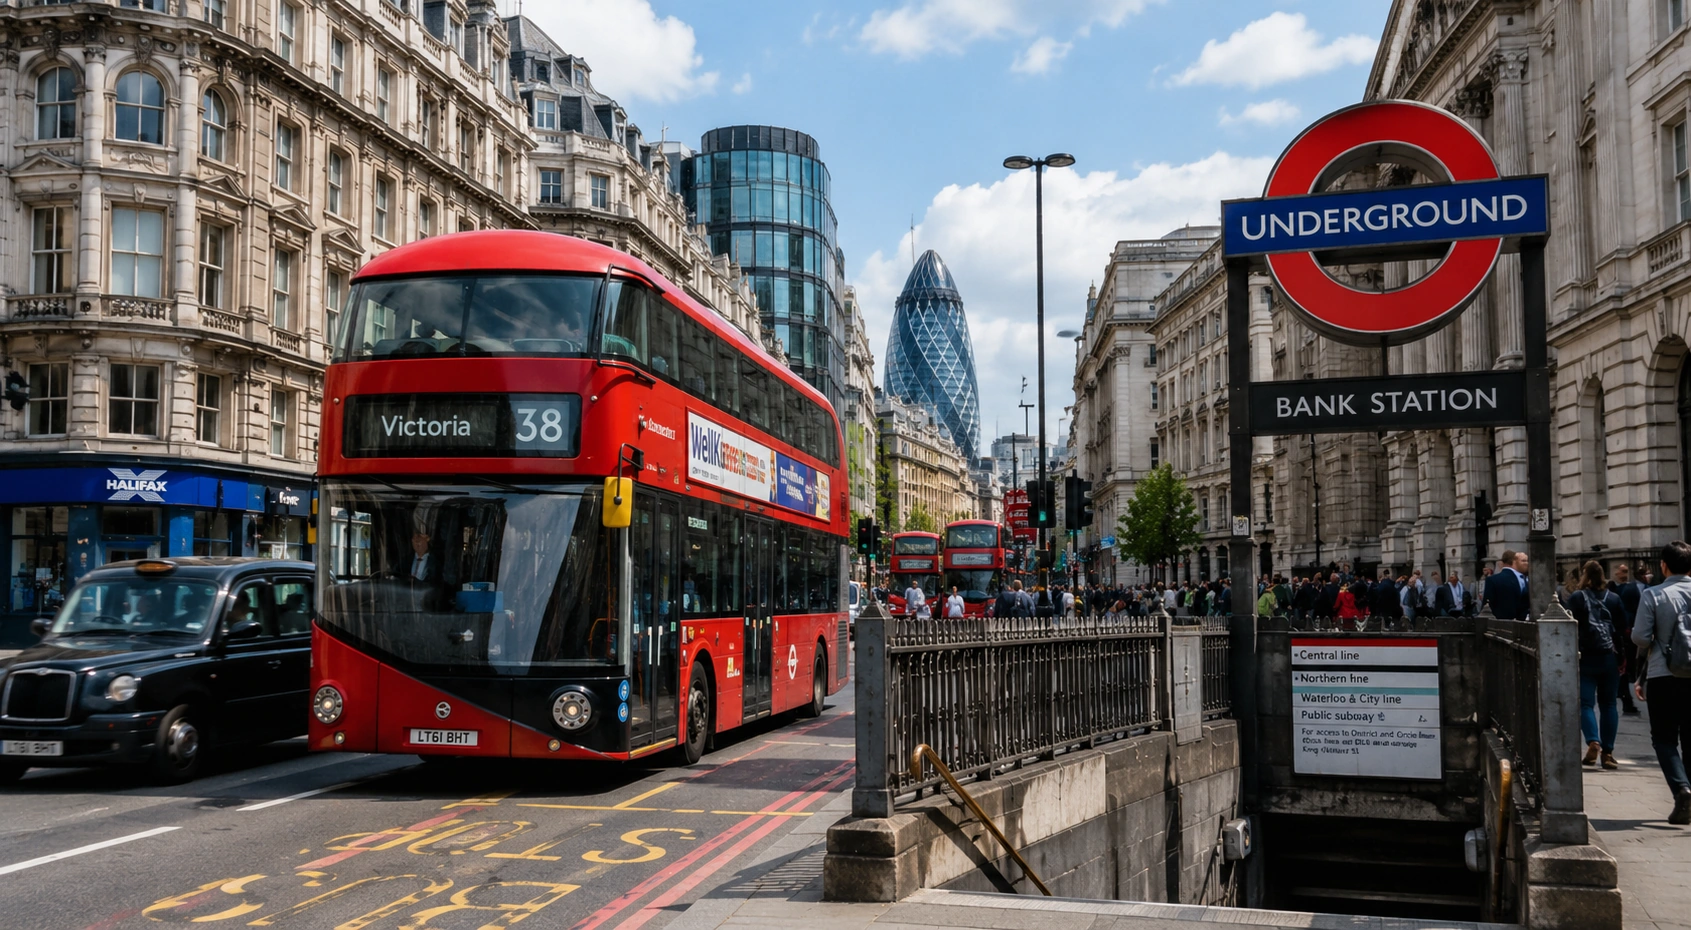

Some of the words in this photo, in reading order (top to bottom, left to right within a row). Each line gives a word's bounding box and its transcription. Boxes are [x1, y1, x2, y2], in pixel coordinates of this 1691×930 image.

[1241, 194, 1528, 241] UNDERGROUND
[1276, 394, 1357, 418] BANK
[1371, 388, 1498, 414] STATION
[381, 414, 471, 437] Victoria
[515, 408, 563, 443] 38
[106, 479, 168, 492] HALIFAX
[1299, 650, 1338, 660] Central
[1340, 650, 1360, 660] line
[1300, 673, 1347, 683] Northern
[1301, 693, 1346, 703] Waterloo
[1359, 694, 1380, 705] City
[1383, 694, 1402, 704] line
[1301, 710, 1332, 720] Public
[417, 730, 443, 743] LT61
[446, 731, 470, 744] BHT
[1301, 728, 1314, 736] For
